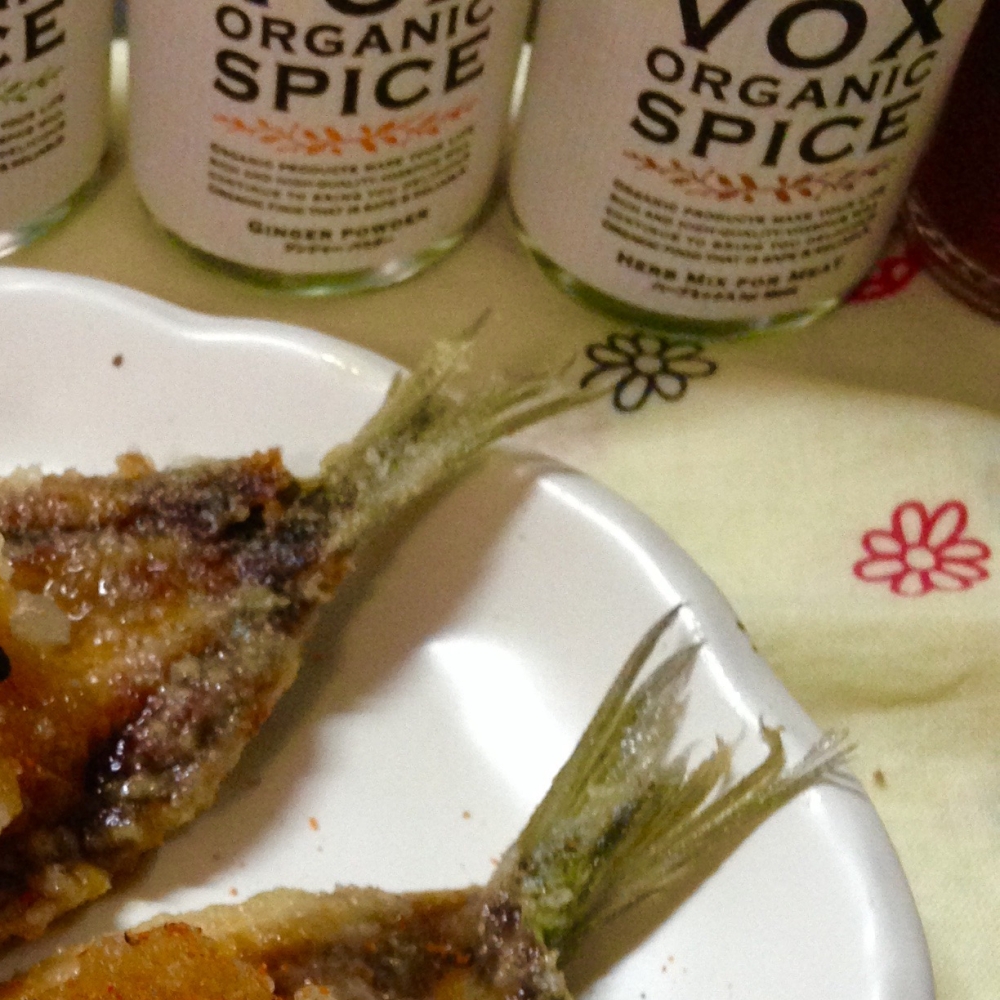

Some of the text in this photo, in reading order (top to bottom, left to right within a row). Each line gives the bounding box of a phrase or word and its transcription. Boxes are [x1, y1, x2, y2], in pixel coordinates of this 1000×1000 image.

[214, 0, 494, 57] ORGANIC
[678, 0, 944, 70] VOX
[213, 26, 490, 116] SPICE
[645, 45, 938, 110] ORGANIC
[630, 91, 922, 167] SPICE
